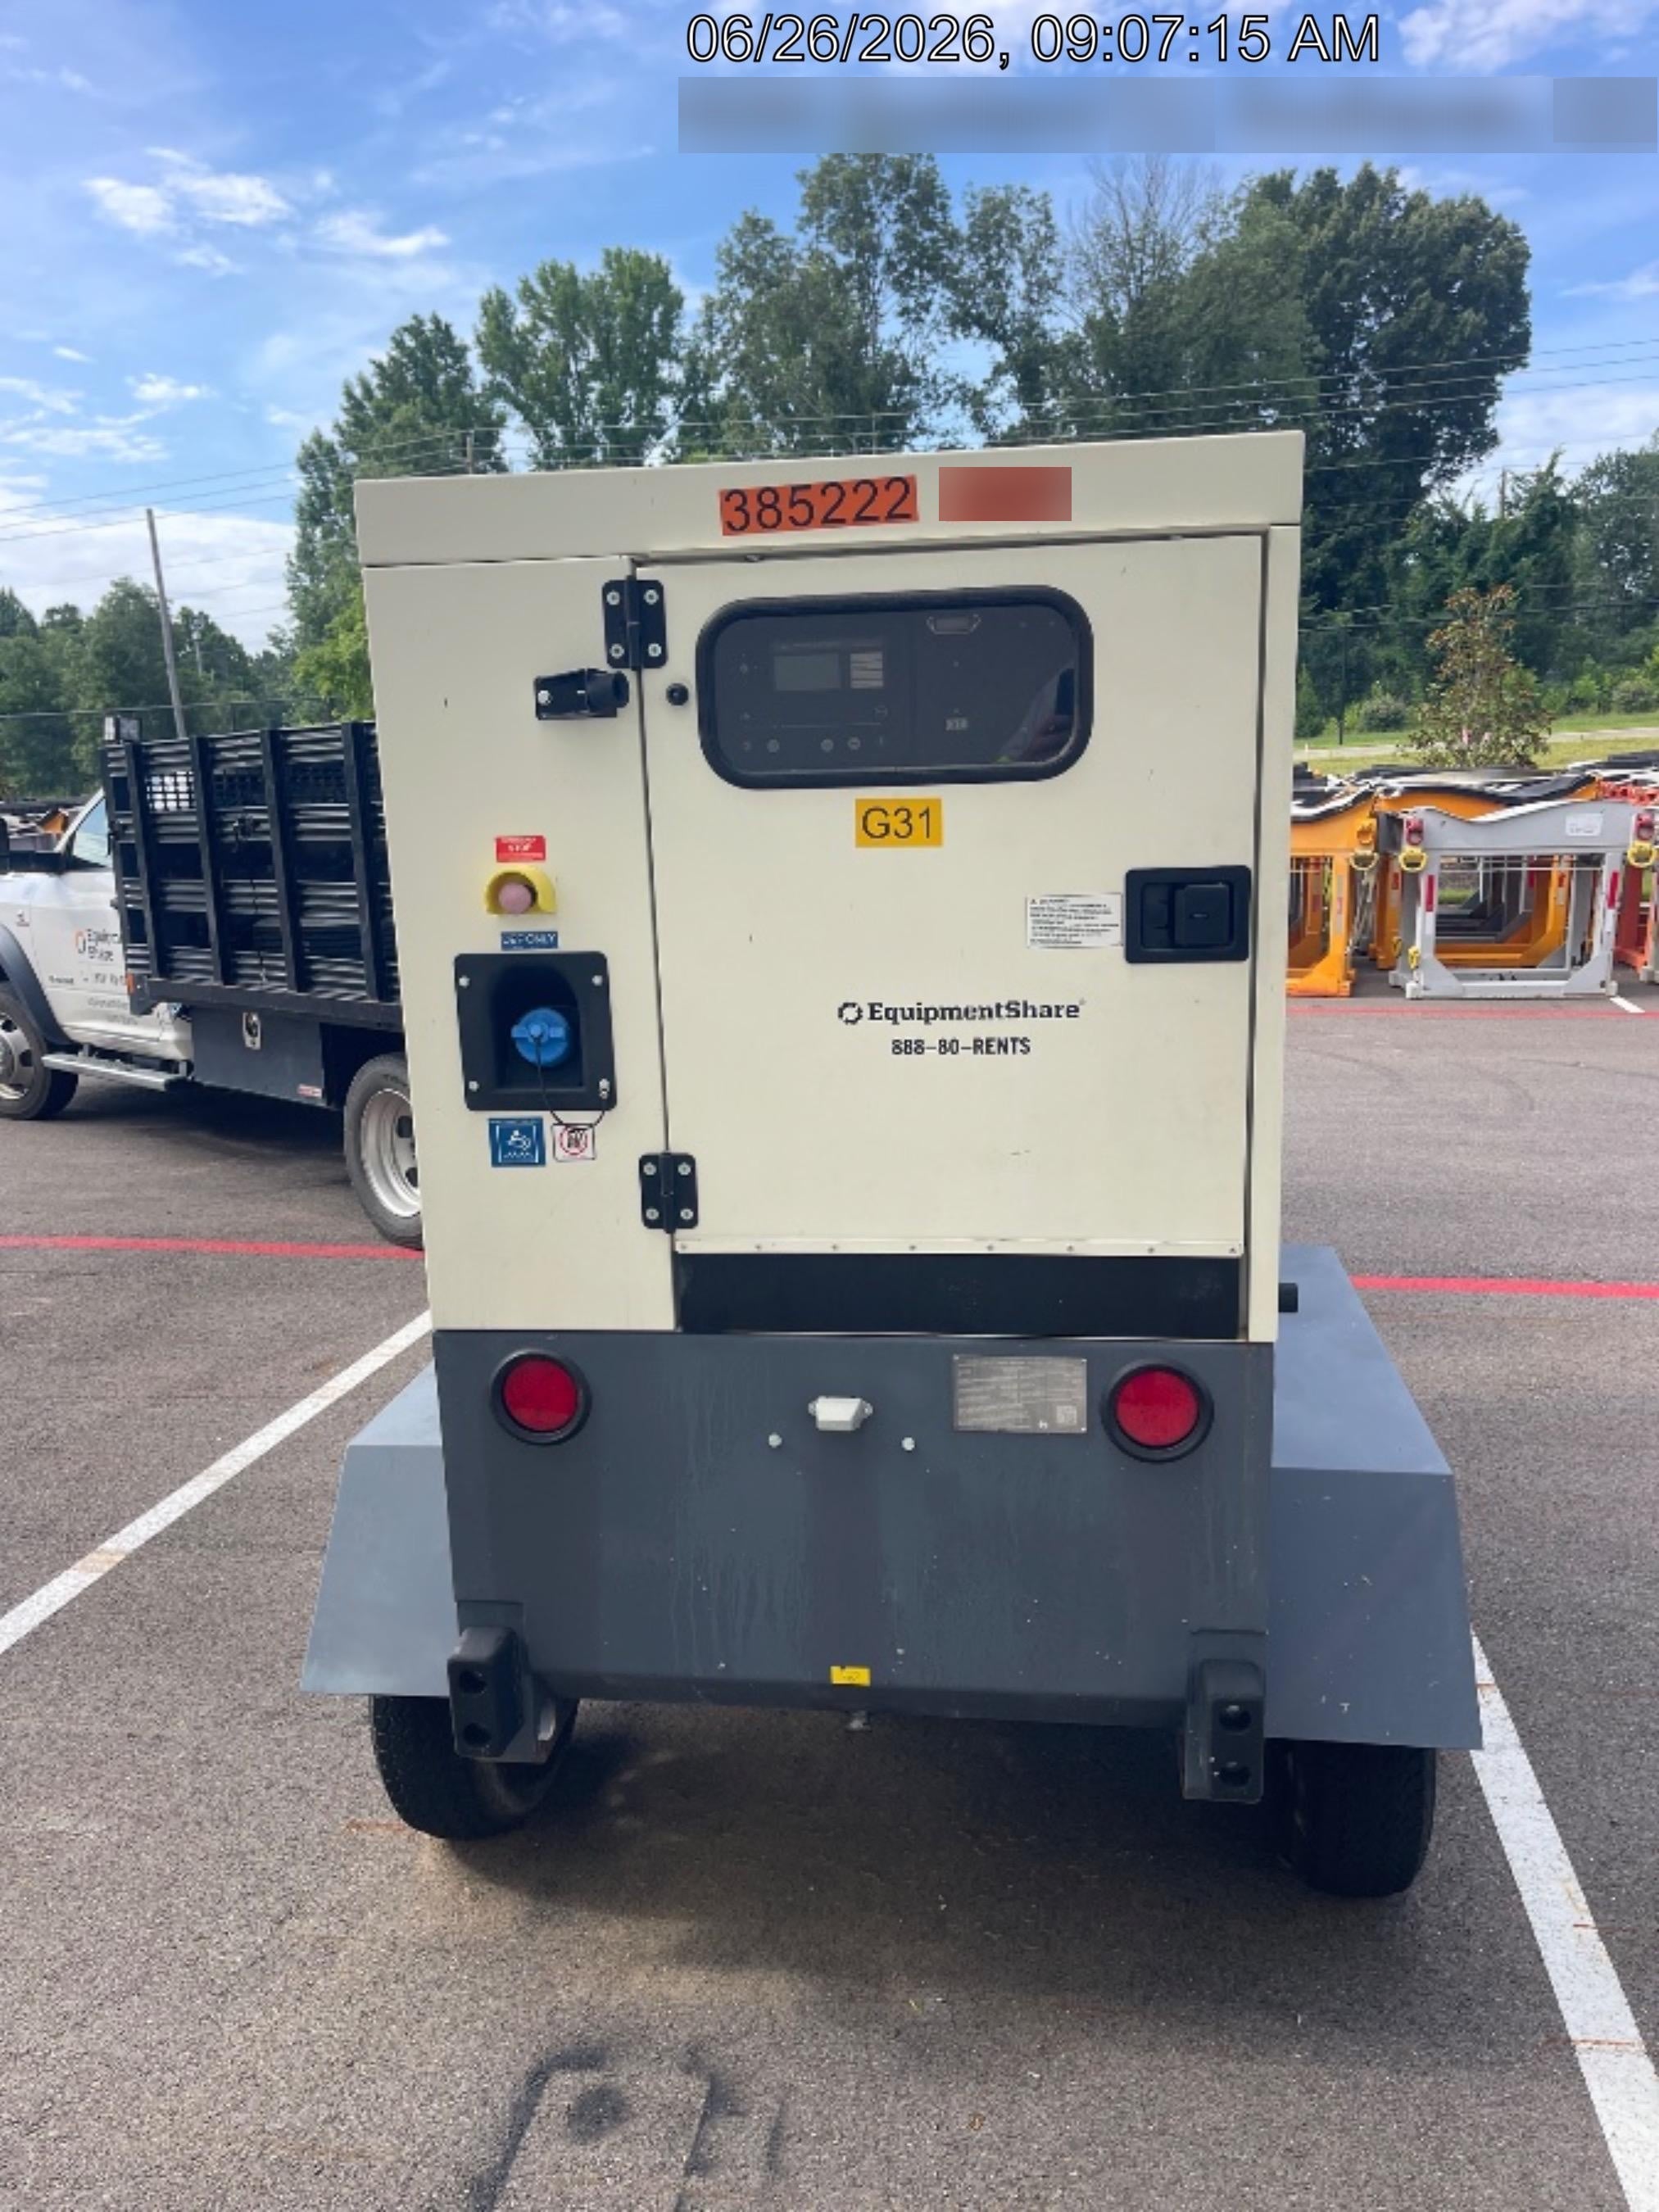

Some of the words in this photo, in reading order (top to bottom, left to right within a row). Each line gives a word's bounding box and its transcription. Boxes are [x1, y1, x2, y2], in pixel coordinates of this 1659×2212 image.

[724, 476, 912, 533] 385222
[862, 806, 930, 839] G31
[868, 999, 1080, 1024] EquipmentShare
[891, 1036, 1031, 1055] 888-80-RENTS
